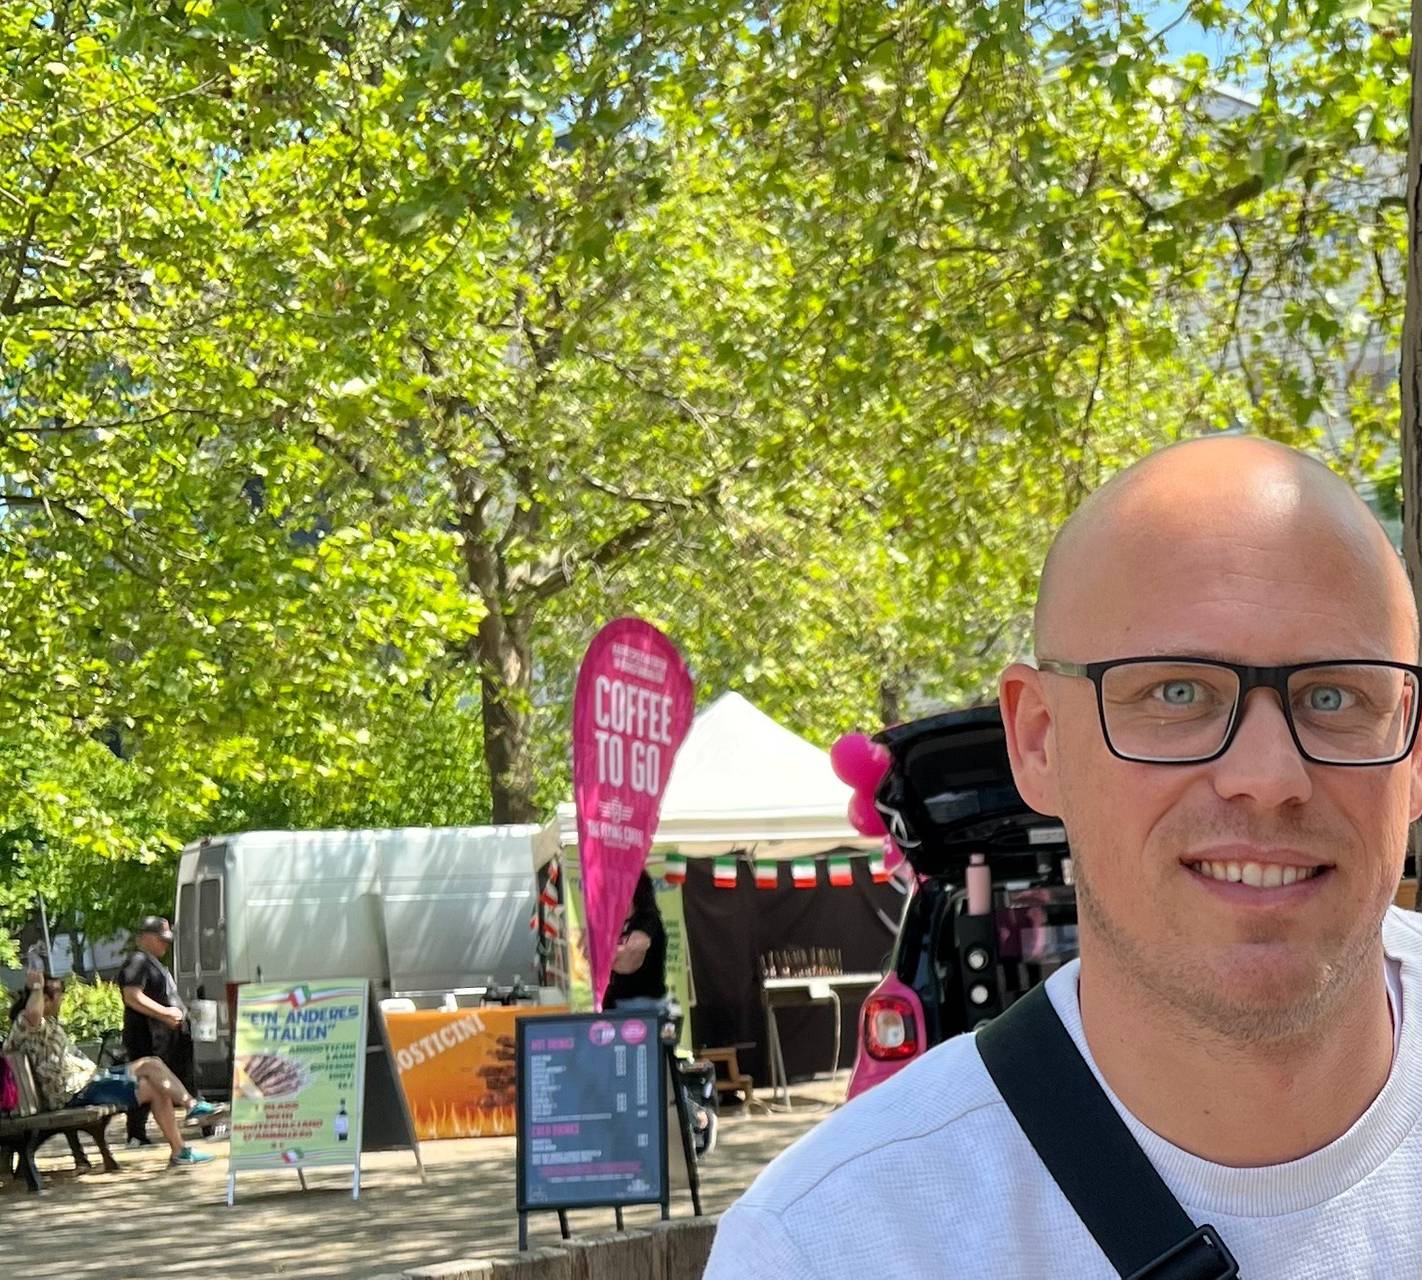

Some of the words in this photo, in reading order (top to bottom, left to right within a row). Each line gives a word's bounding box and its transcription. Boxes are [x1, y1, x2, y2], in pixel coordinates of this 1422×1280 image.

[594, 674, 673, 747] COFFEE
[594, 729, 624, 788] TO
[630, 739, 661, 797] GO
[286, 1004, 360, 1024] ANDERES
[397, 1012, 486, 1074] OSTICINI
